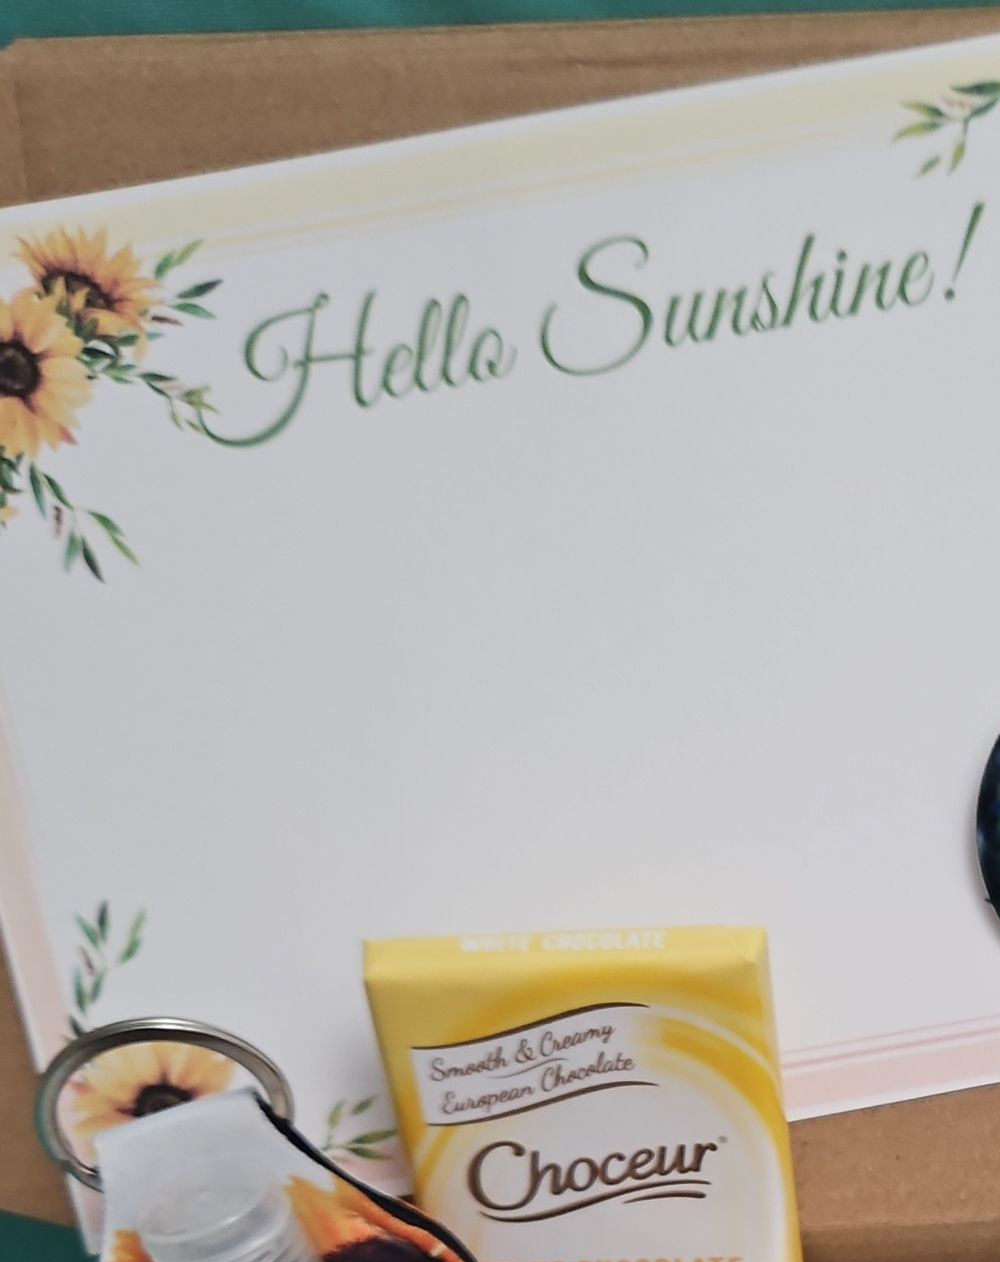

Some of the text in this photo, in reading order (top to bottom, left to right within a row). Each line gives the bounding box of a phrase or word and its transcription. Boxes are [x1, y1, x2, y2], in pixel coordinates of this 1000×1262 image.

[198, 203, 986, 449] Hello Sunshine!
[461, 930, 667, 952] WHITE CHOCOLATE
[429, 1023, 616, 1083] Smooth & Creamy
[441, 1051, 636, 1116] European Chocolate
